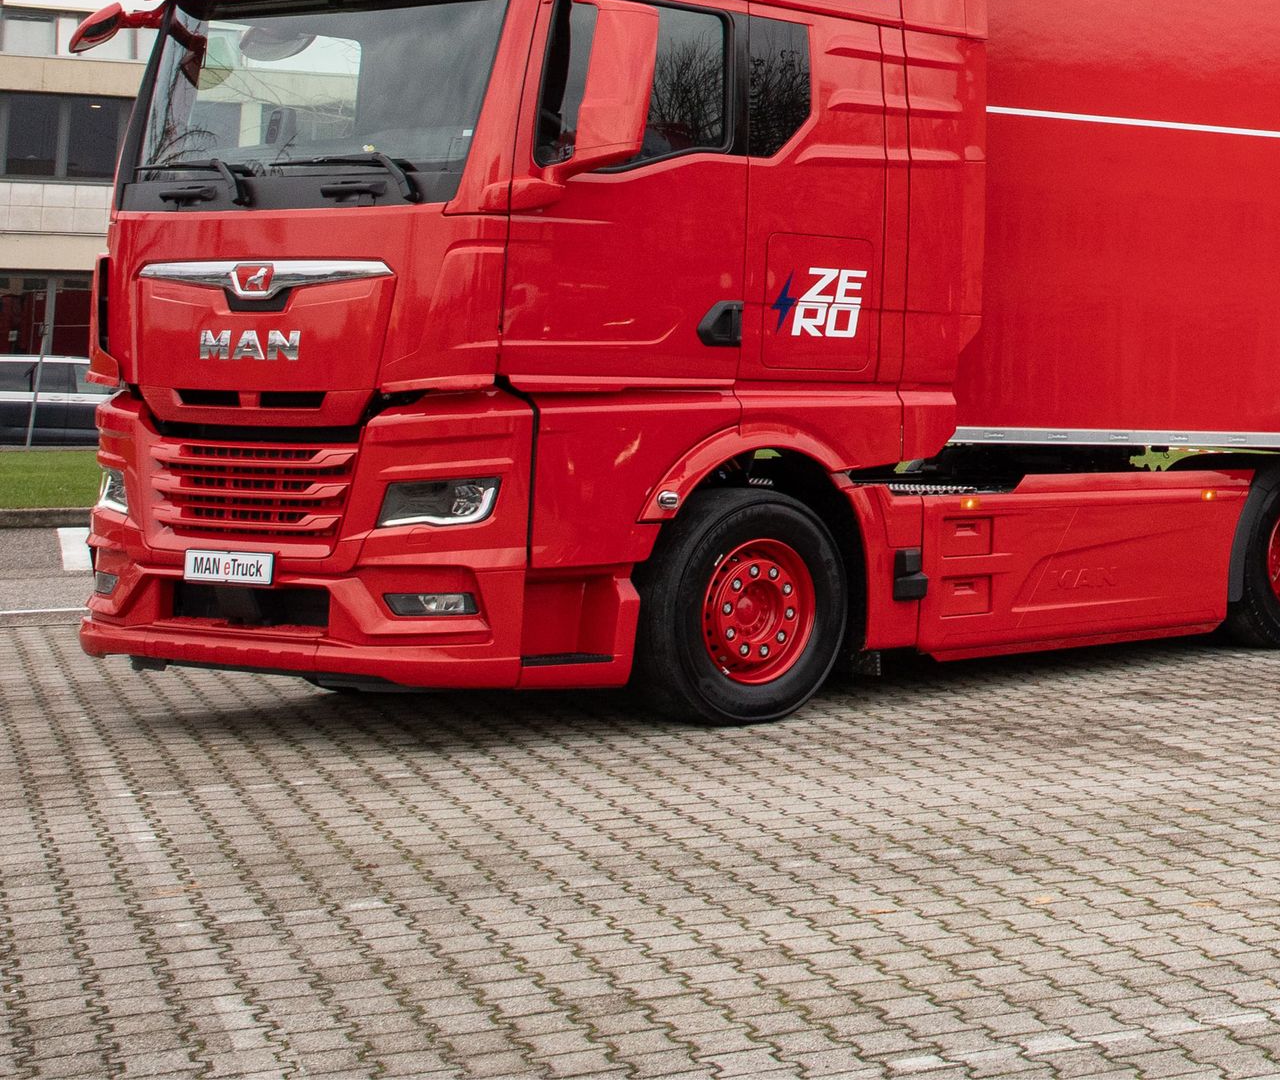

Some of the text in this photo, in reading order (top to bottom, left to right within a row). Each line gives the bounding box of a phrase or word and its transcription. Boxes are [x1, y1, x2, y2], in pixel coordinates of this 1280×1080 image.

[199, 329, 301, 361] MAN
[193, 556, 263, 578] MAN eTruck
